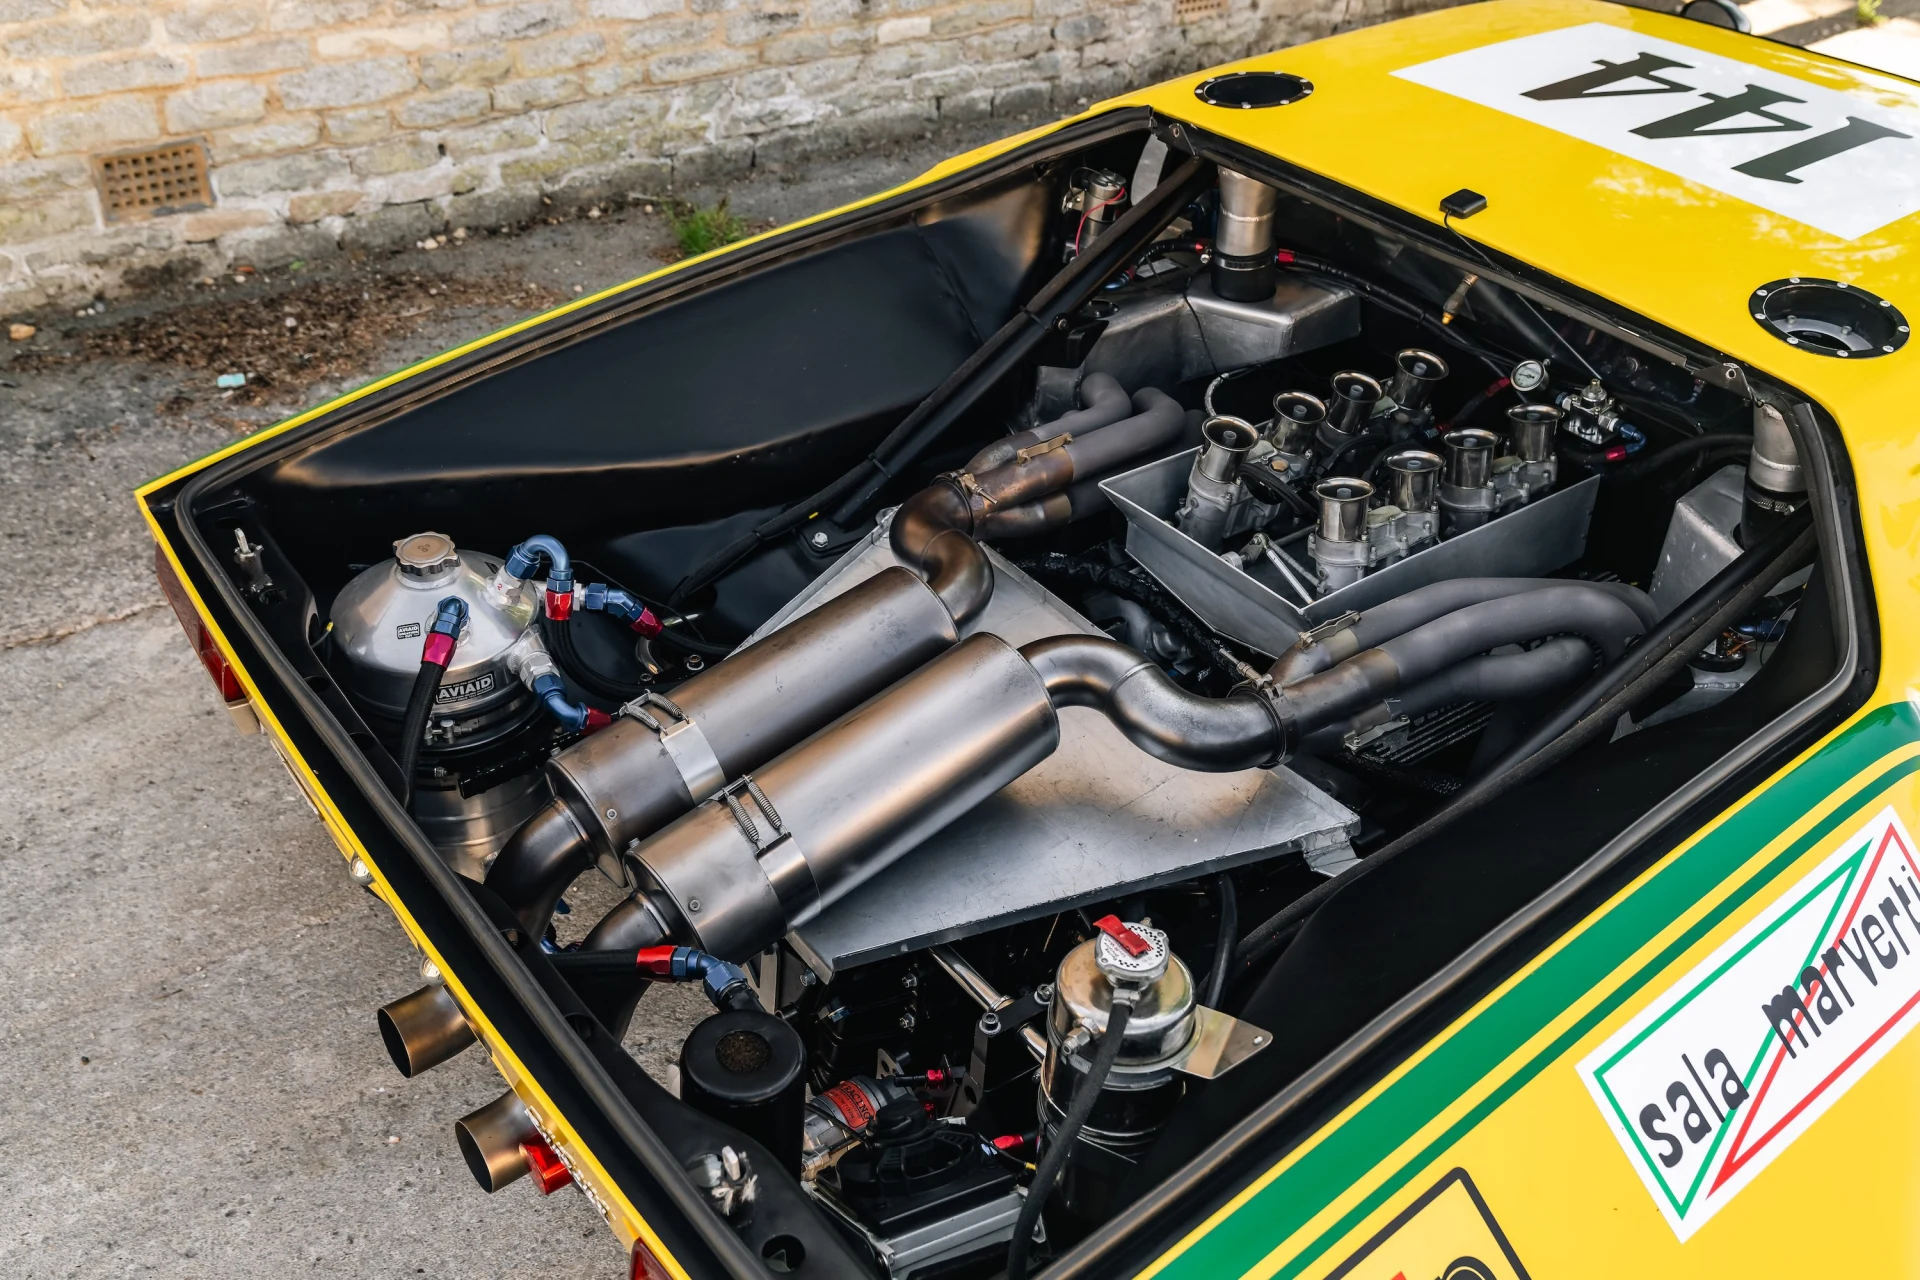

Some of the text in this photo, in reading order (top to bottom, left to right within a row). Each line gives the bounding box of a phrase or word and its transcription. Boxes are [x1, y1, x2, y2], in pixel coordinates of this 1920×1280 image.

[1519, 52, 1914, 184] 144
[438, 677, 492, 699] AVIAID
[1639, 1047, 1750, 1168] sala
